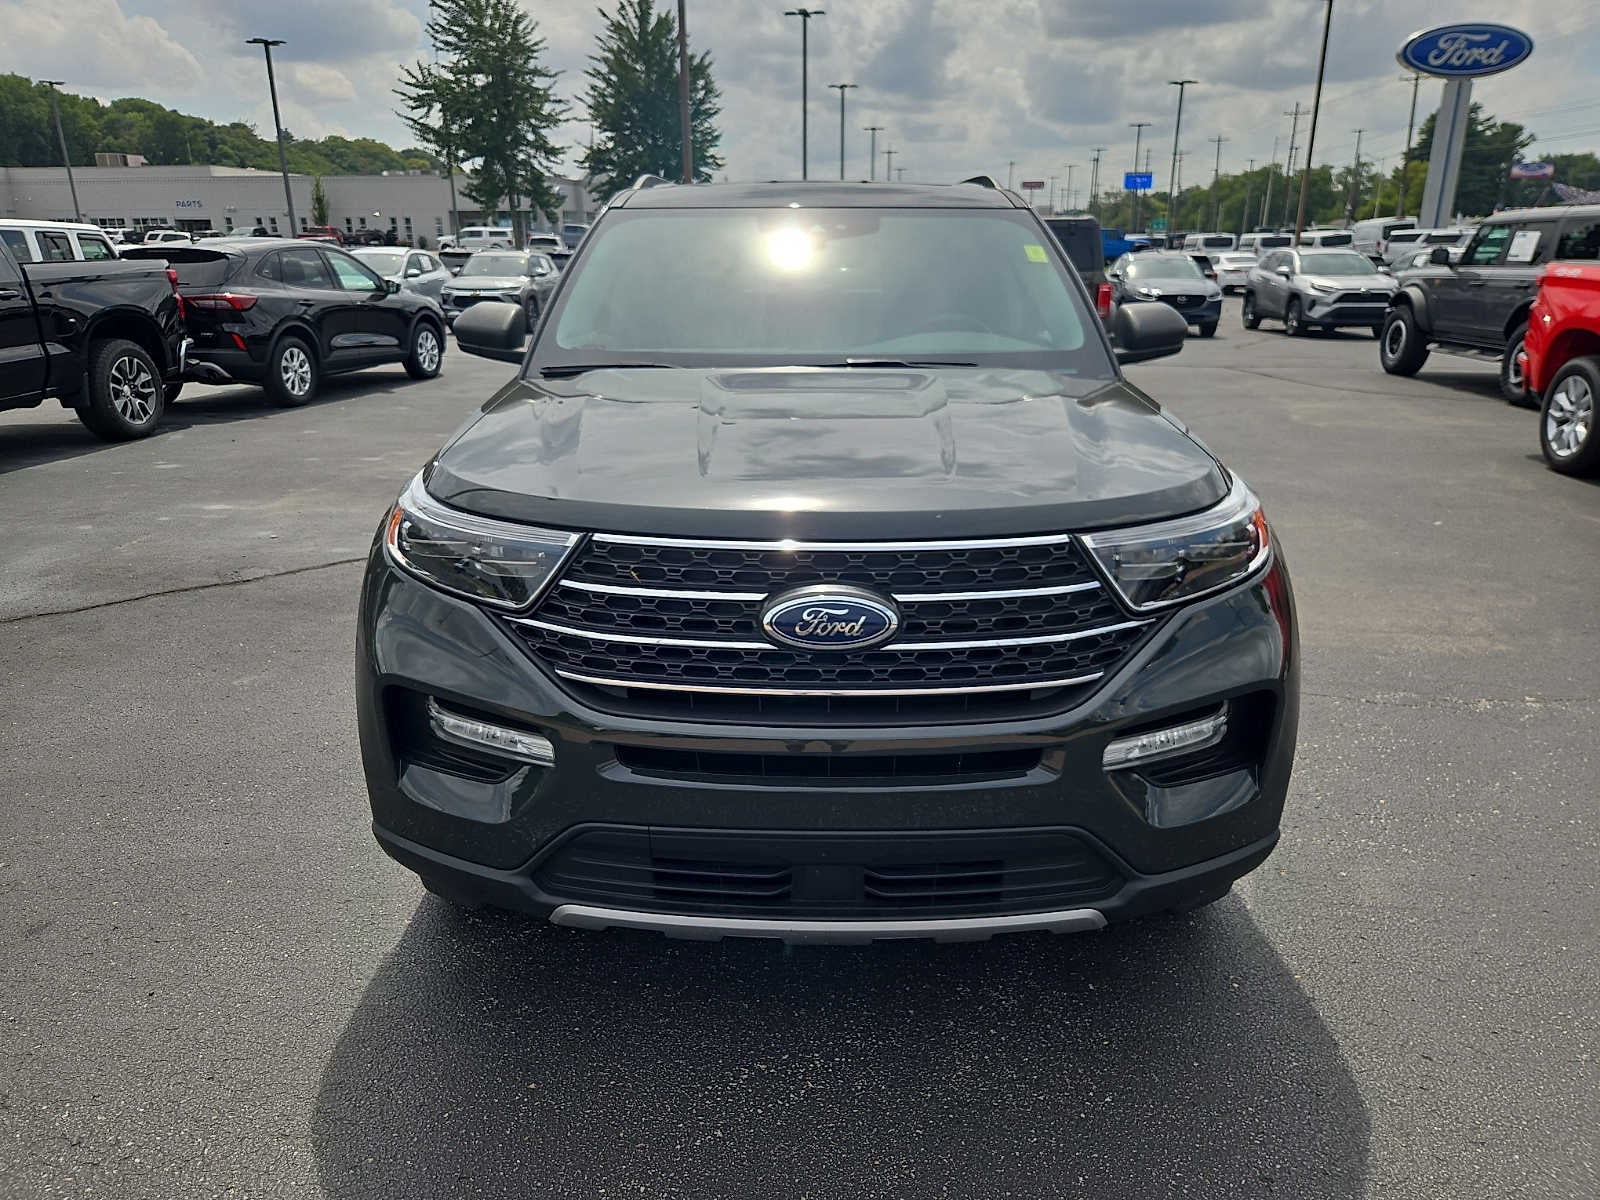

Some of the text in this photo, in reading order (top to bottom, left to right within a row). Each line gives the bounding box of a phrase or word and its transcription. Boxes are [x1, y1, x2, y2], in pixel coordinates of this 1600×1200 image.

[1428, 32, 1509, 66] Ford
[175, 200, 203, 208] PARTS
[795, 607, 866, 637] Ford
